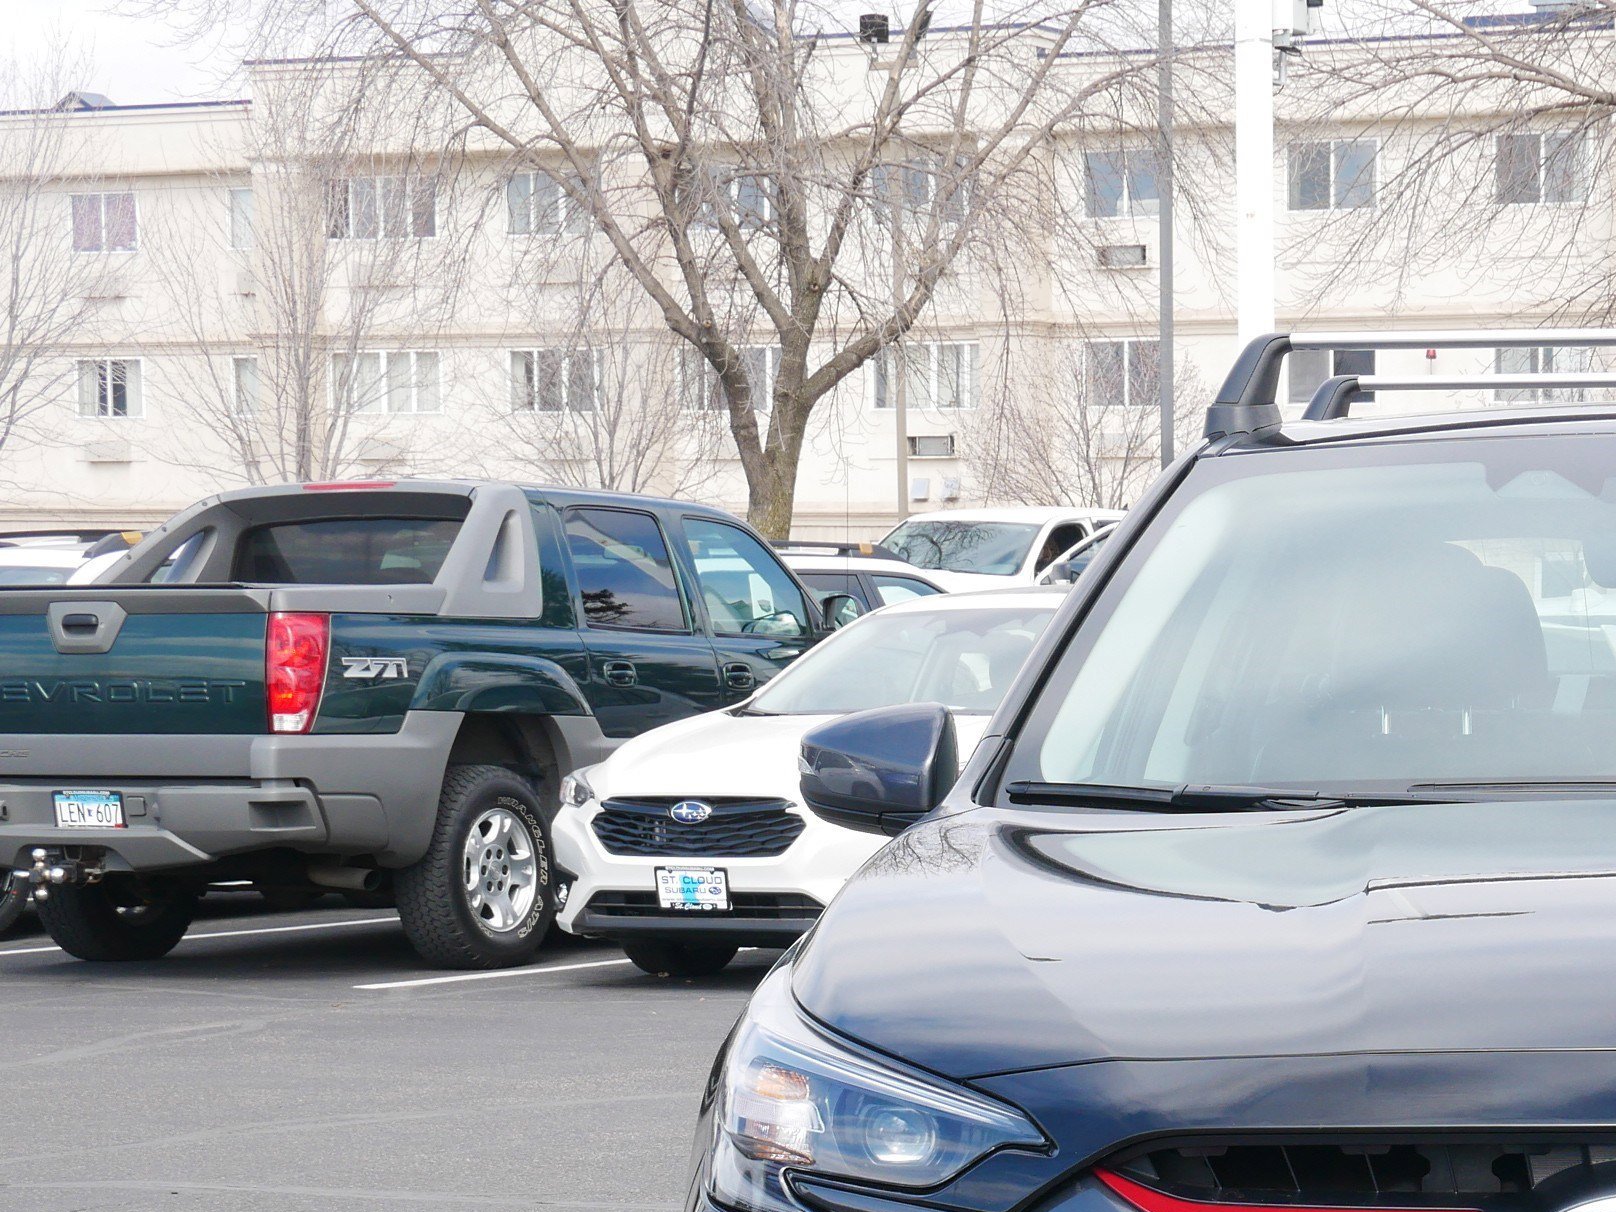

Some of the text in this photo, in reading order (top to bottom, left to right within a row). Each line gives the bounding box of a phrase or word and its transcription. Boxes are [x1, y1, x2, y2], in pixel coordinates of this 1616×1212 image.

[342, 656, 408, 678] Z71
[96, 803, 119, 824] 607
[661, 875, 723, 885] ST. CLOUD
[664, 886, 707, 894] SUBARU
